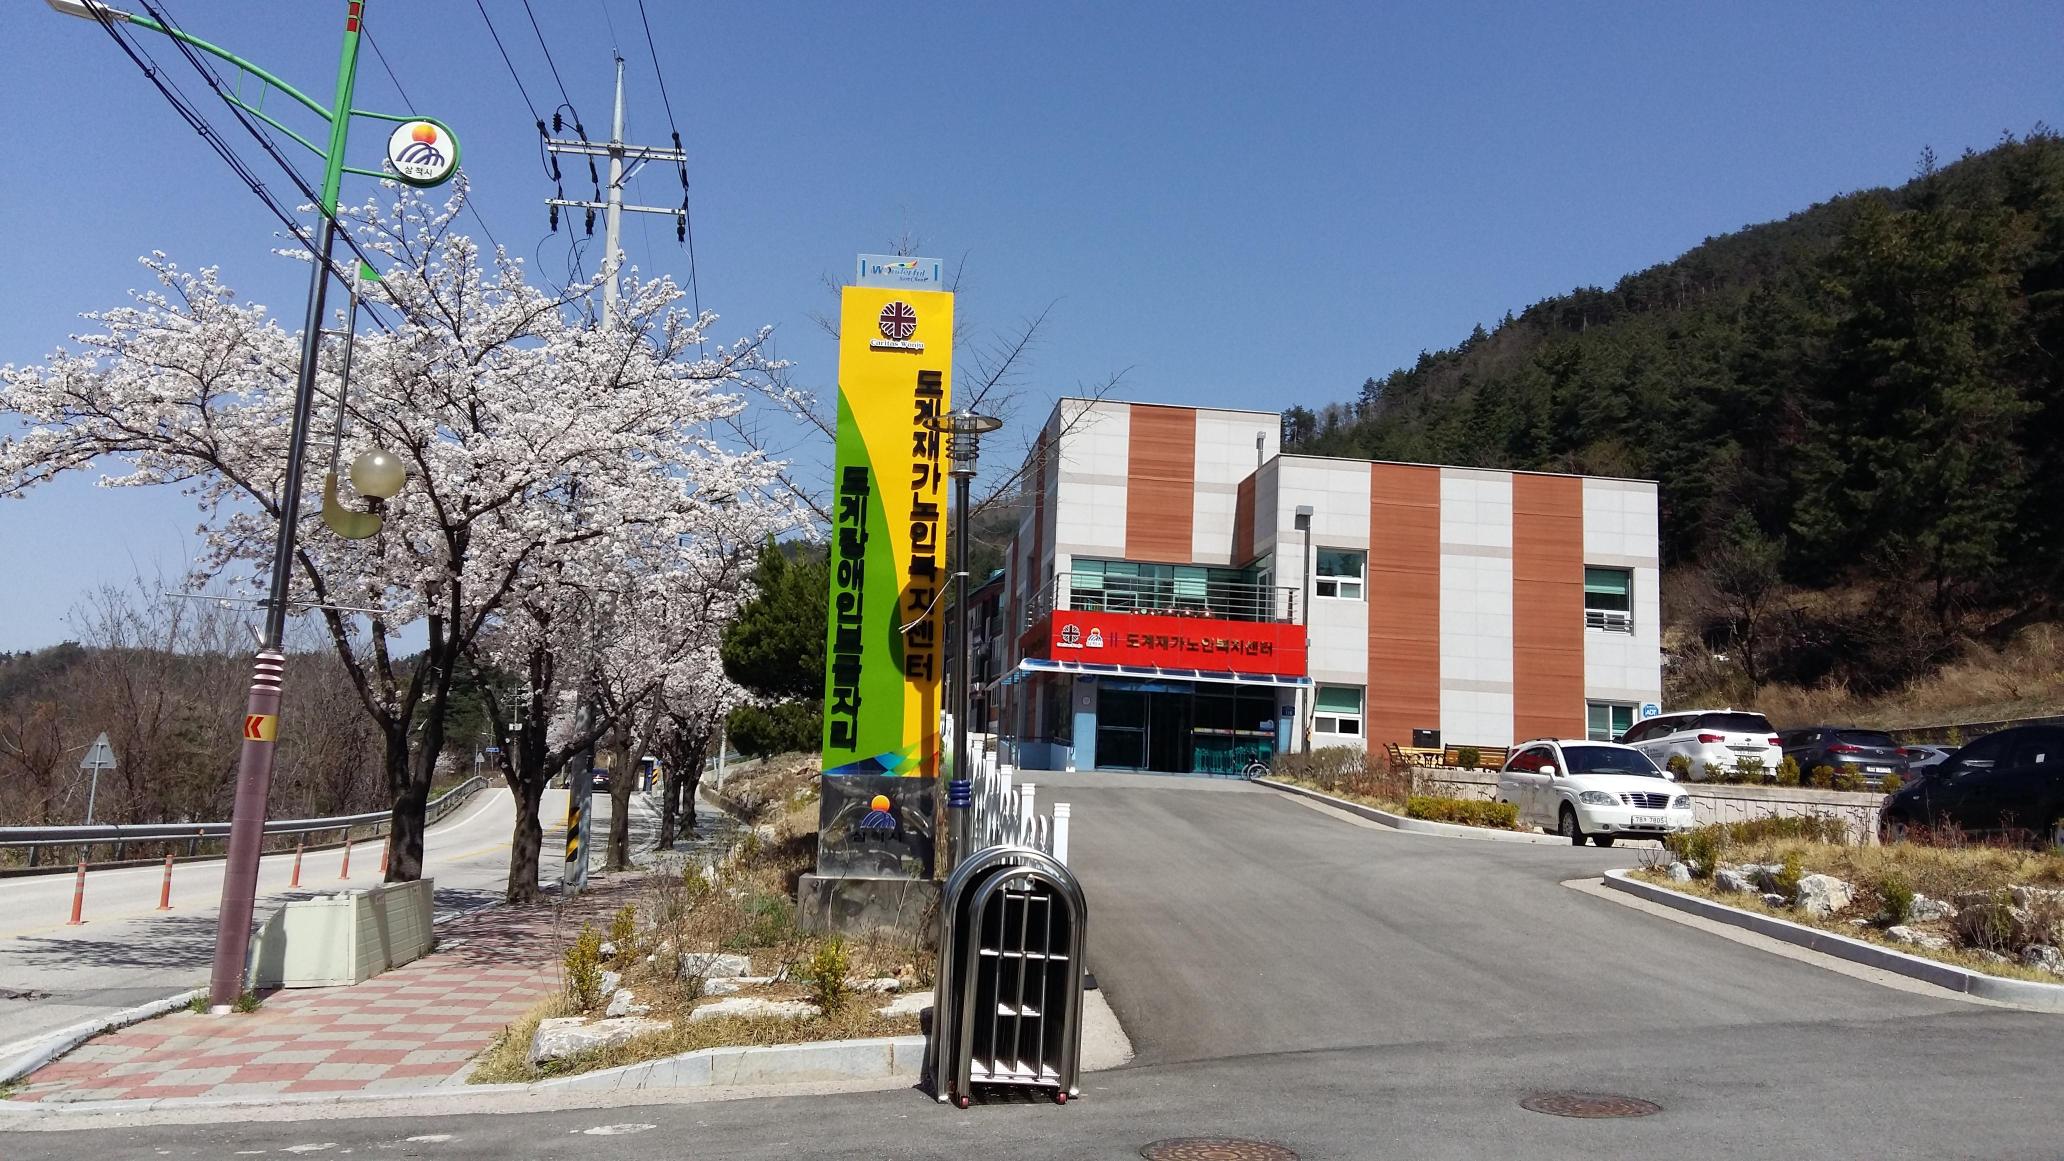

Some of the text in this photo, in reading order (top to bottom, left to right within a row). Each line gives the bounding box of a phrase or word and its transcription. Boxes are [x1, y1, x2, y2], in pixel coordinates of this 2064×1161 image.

[404, 166, 433, 177] 삼척시
[871, 339, 924, 349] Caritas Wonju
[903, 368, 944, 683] 도계재가노인복지센터
